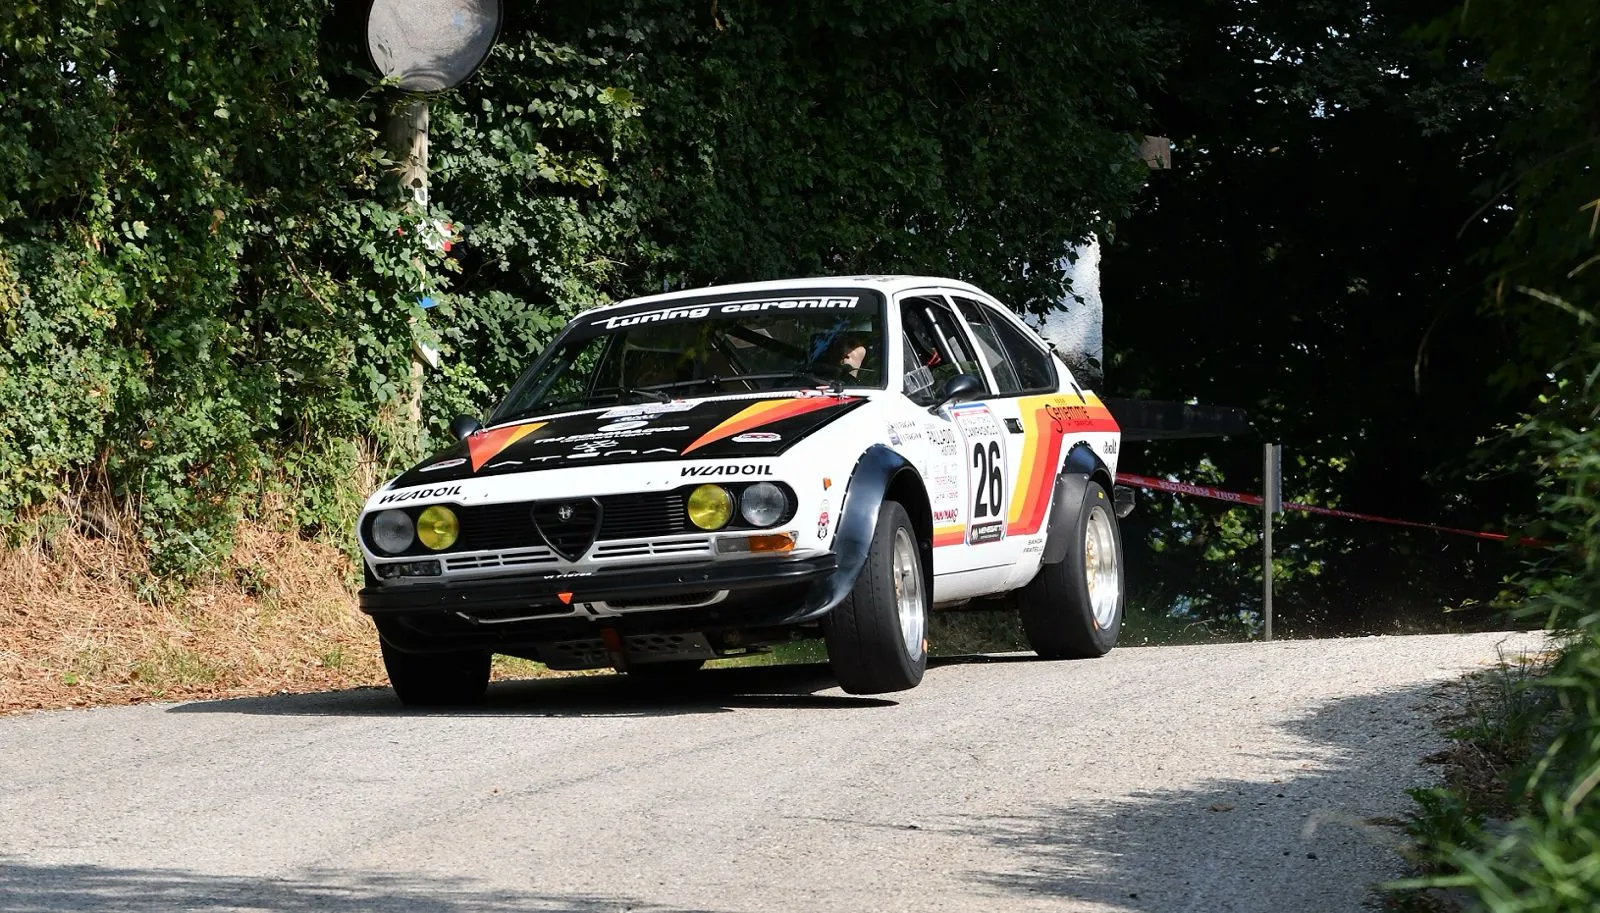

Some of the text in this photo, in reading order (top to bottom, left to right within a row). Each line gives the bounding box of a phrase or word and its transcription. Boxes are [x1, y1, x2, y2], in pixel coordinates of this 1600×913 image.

[591, 304, 711, 330] tuning
[926, 429, 956, 446] PALLADIO
[973, 440, 1003, 518] 26
